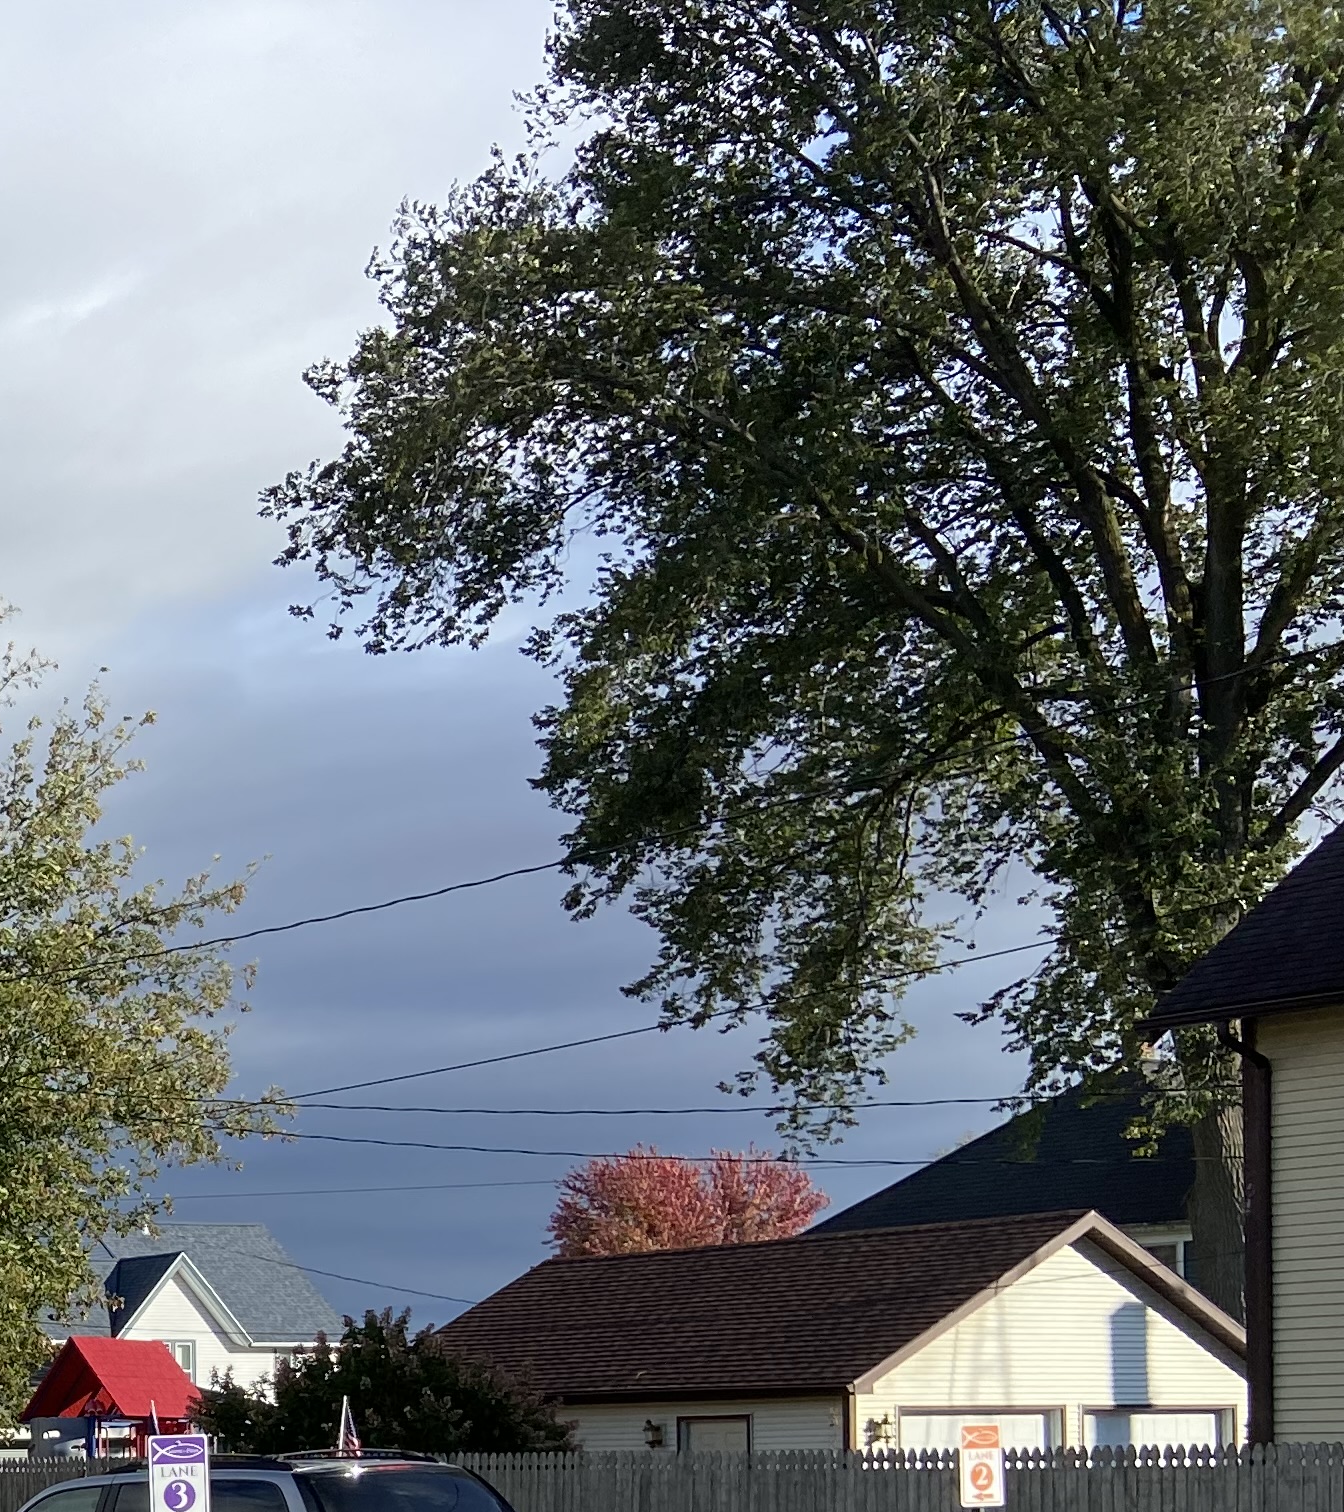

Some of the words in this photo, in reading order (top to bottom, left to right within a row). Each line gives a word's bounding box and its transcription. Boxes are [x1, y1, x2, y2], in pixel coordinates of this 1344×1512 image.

[968, 1451, 994, 1461] LANE
[160, 1466, 199, 1478] LANE
[975, 1466, 989, 1485] 2
[171, 1482, 188, 1509] 3
